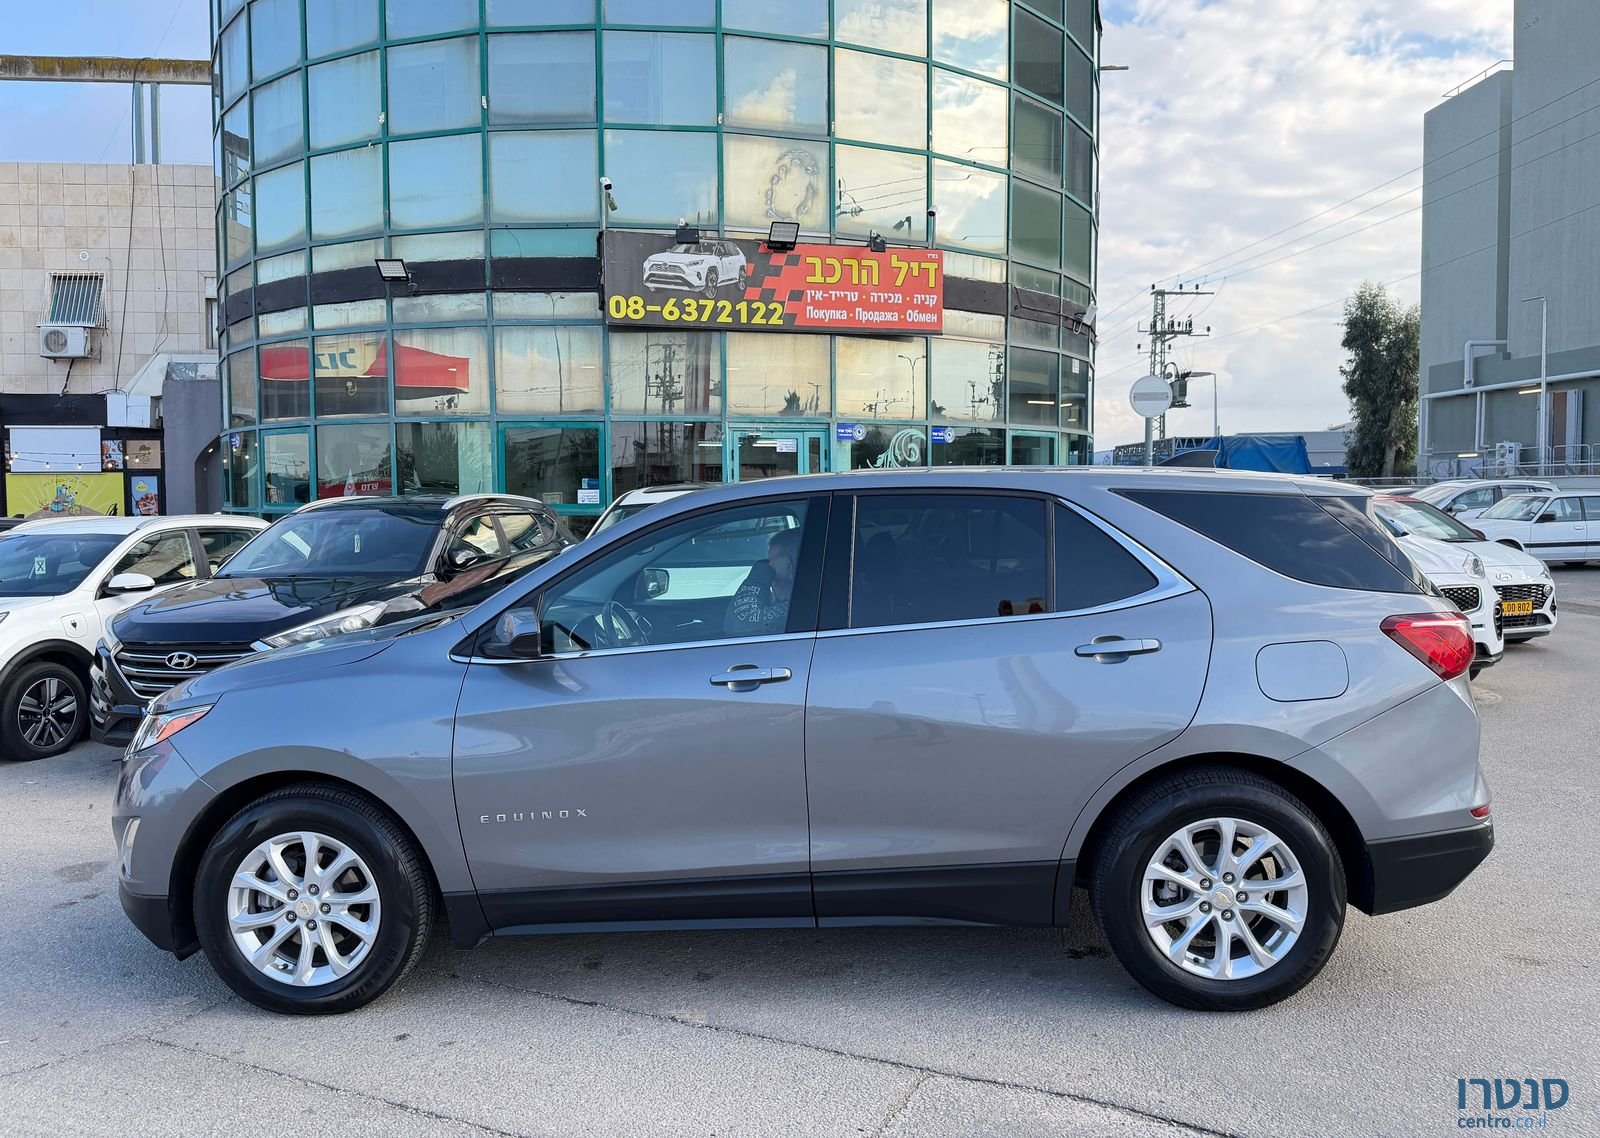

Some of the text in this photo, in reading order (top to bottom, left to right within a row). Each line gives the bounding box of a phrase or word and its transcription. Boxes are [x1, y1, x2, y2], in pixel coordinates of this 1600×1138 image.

[805, 254, 939, 288] דיל הרכב
[806, 289, 938, 308] קניה מכירה טרייד-אין
[608, 295, 784, 325] 08-6372122
[806, 305, 938, 323] Покупка Продажа Обмен
[480, 808, 588, 824] EQUINOX
